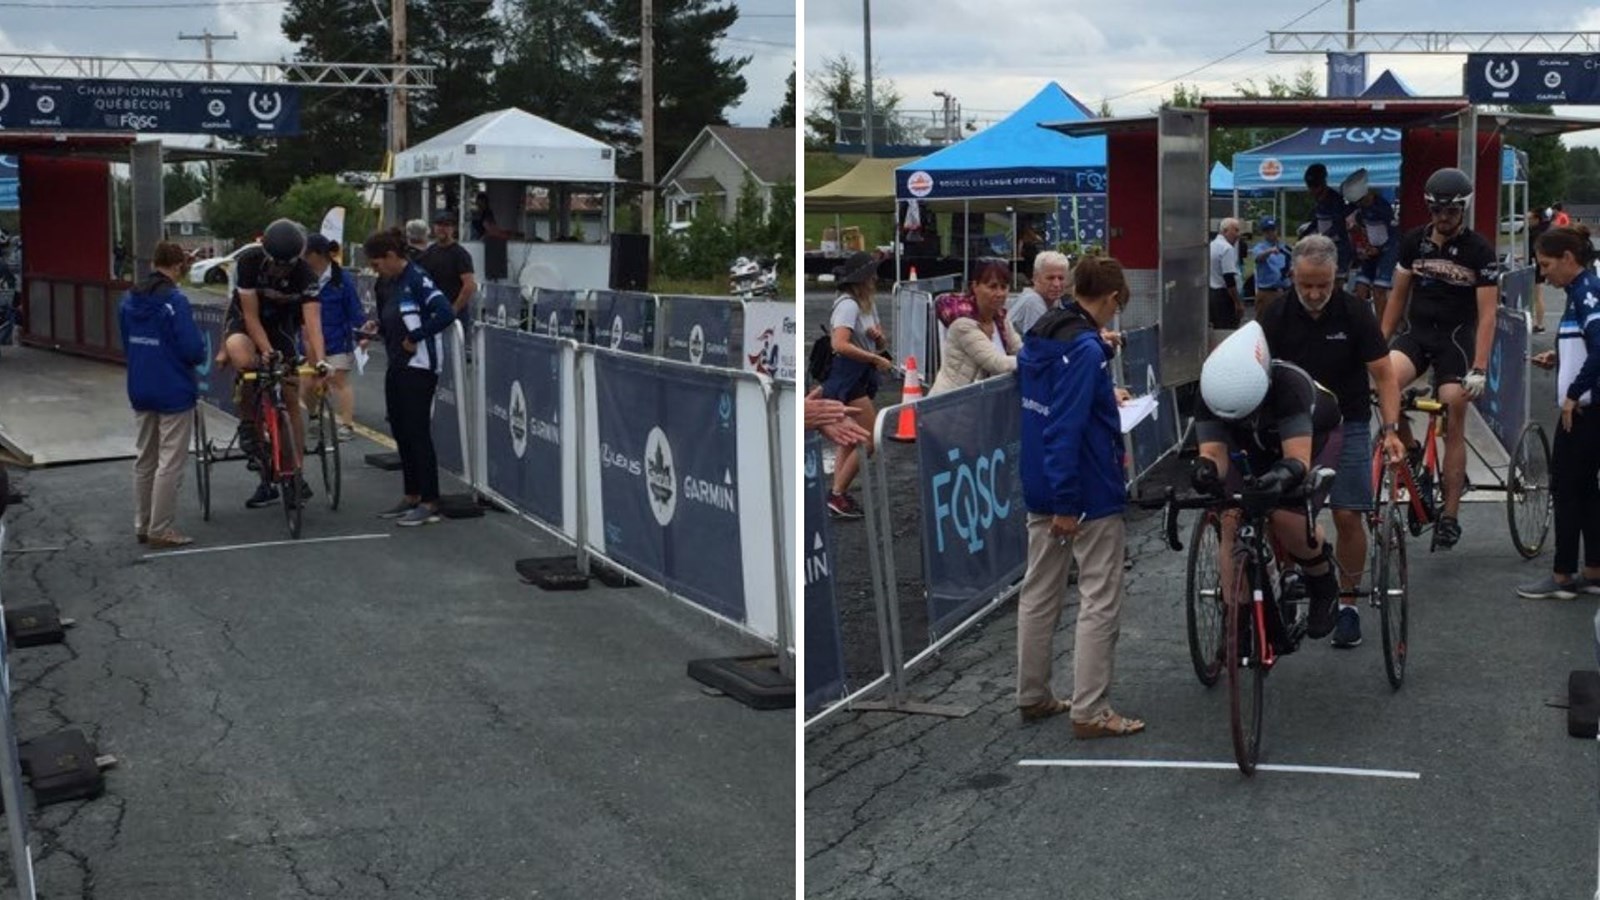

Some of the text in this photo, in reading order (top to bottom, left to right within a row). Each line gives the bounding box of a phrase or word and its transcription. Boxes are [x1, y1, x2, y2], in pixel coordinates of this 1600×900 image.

[77, 85, 184, 98] CHAMPIONNATS
[683, 474, 735, 513] GARMIN
[932, 447, 1011, 555] FQSC
